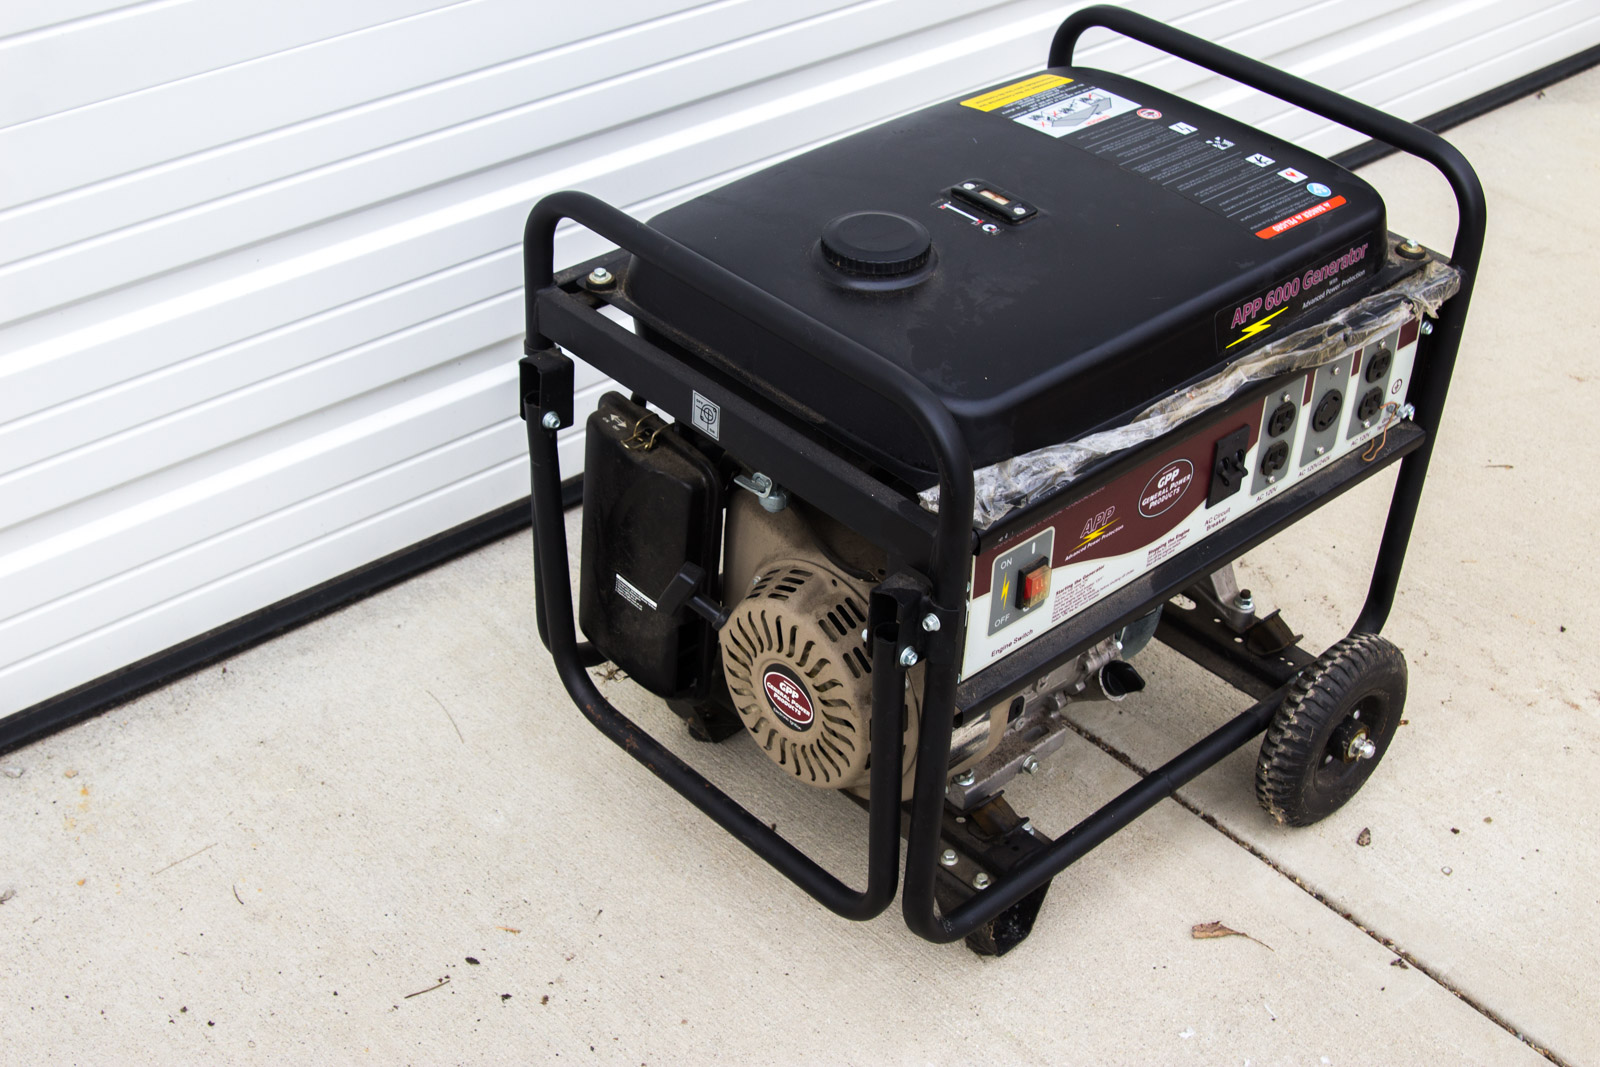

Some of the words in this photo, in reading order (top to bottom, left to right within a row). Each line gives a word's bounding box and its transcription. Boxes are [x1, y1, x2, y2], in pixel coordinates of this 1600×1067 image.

[1304, 204, 1326, 220] DANGER
[1271, 216, 1299, 232] PELIGRO
[1231, 297, 1262, 329] APP
[1265, 277, 1299, 310] 6000
[1302, 243, 1368, 290] Generator
[1302, 292, 1325, 310] Advanced
[1325, 284, 1341, 297] Power
[1341, 270, 1366, 288] Protection
[1351, 438, 1359, 447] AC
[1359, 431, 1371, 442] 120V
[1157, 468, 1180, 489] GPP
[1298, 468, 1307, 477] AC
[1142, 488, 1168, 506] GENERAL
[1169, 474, 1191, 490] POWER
[1149, 487, 1181, 510] PRODUCTS
[1256, 493, 1265, 503] AC
[1265, 486, 1278, 497] 120V
[1080, 506, 1115, 539] APP
[1204, 516, 1213, 526] AC
[1213, 507, 1231, 519] Circuit
[1206, 517, 1227, 532] Breaker
[1065, 547, 1087, 561] Advanced
[1087, 537, 1101, 549] Power
[1102, 524, 1124, 540] Protection
[1176, 528, 1190, 539] Engine
[1000, 558, 1013, 570] ON
[1056, 582, 1074, 595] Starting
[1074, 577, 1082, 585] the
[1082, 565, 1105, 580] Generator
[994, 613, 1011, 627] OFF
[991, 642, 1012, 658] Engine
[1013, 629, 1034, 646] Switch
[767, 682, 790, 702] GENERAL
[791, 699, 810, 716] POWER
[779, 682, 799, 699] GPP
[774, 692, 801, 716] PRODUCTS
